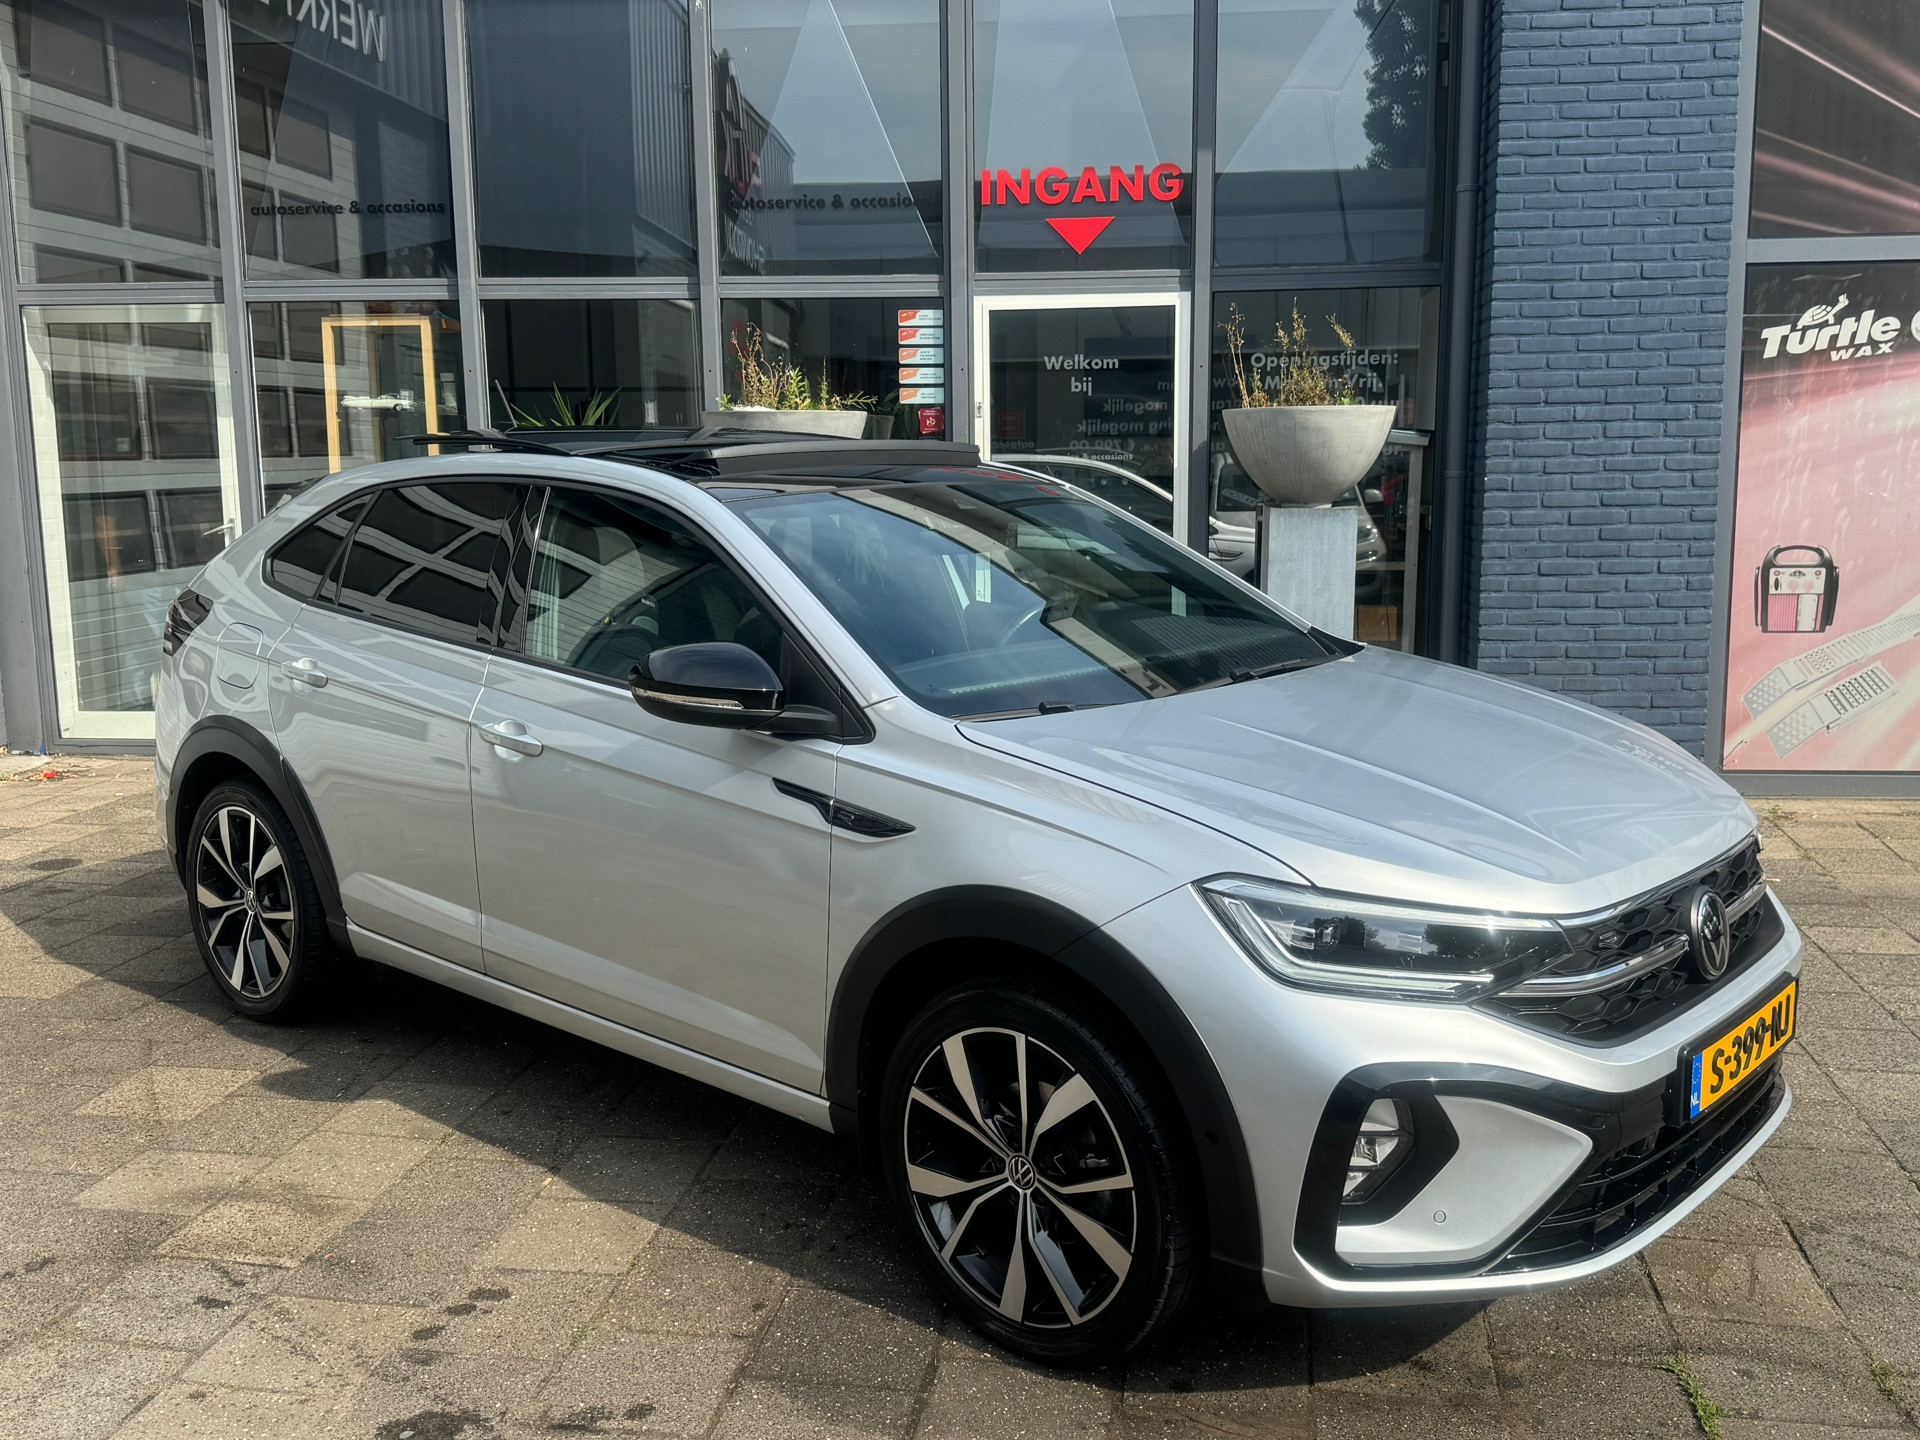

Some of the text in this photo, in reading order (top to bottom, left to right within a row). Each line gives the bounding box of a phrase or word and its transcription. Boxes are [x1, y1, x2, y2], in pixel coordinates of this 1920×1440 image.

[981, 164, 1184, 206] INGANG
[250, 198, 445, 217] autoservice & occasions
[831, 193, 845, 210] &
[851, 191, 930, 209] occasio
[1760, 308, 1902, 360] Turtle
[1830, 341, 1895, 362] WAX
[1043, 353, 1120, 371] Welkom
[1070, 376, 1093, 397] bij
[1091, 452, 1133, 461] occasions
[1690, 1092, 1700, 1107] NL
